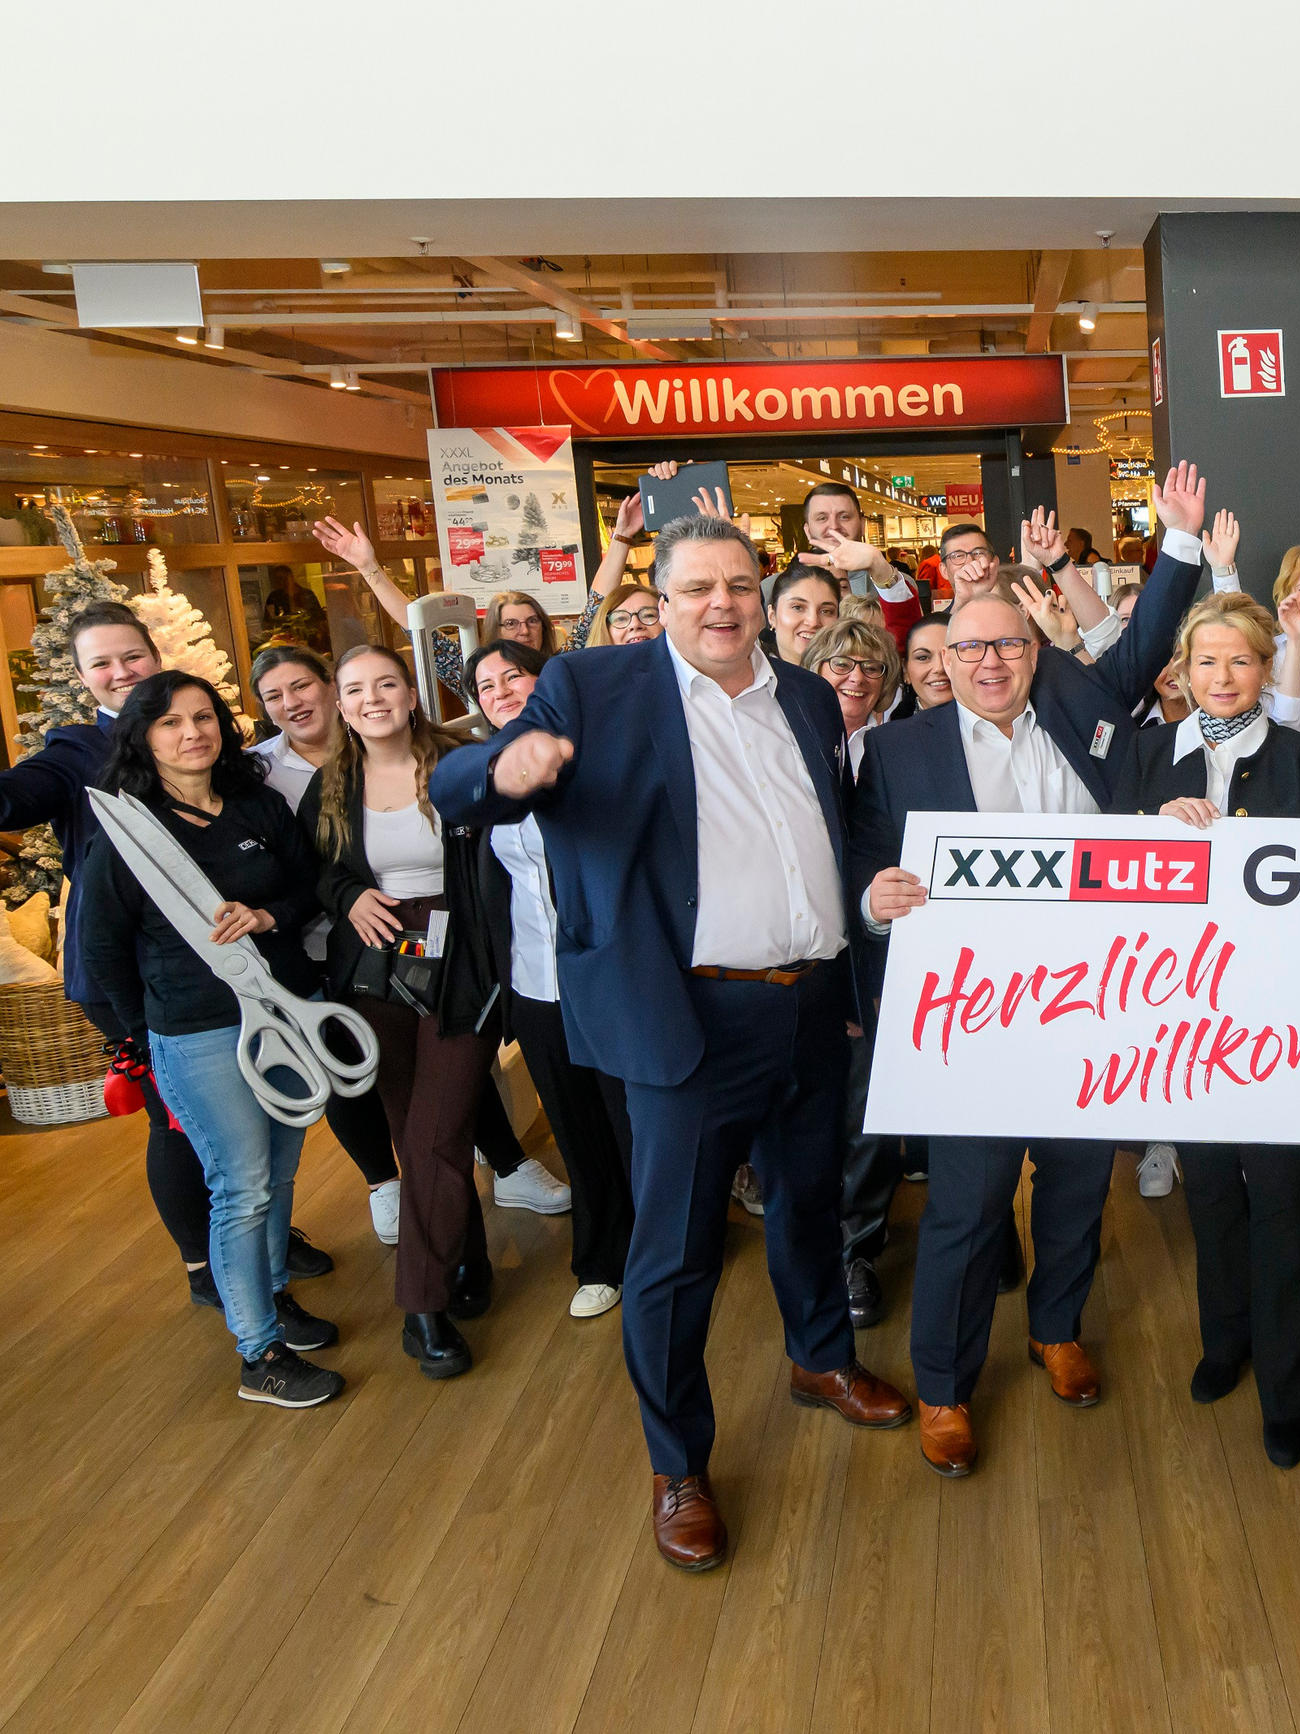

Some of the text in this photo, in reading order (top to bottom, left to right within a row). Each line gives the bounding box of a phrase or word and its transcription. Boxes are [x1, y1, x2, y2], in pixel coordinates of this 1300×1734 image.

[614, 376, 964, 425] Willkommen
[440, 447, 474, 459] XXXL
[442, 460, 504, 474] Angebot
[443, 473, 524, 486] des Monats
[929, 496, 946, 505] WC
[949, 495, 978, 506] NEU
[947, 846, 1197, 893] XXXLutz
[911, 921, 1236, 1065] Herzlich
